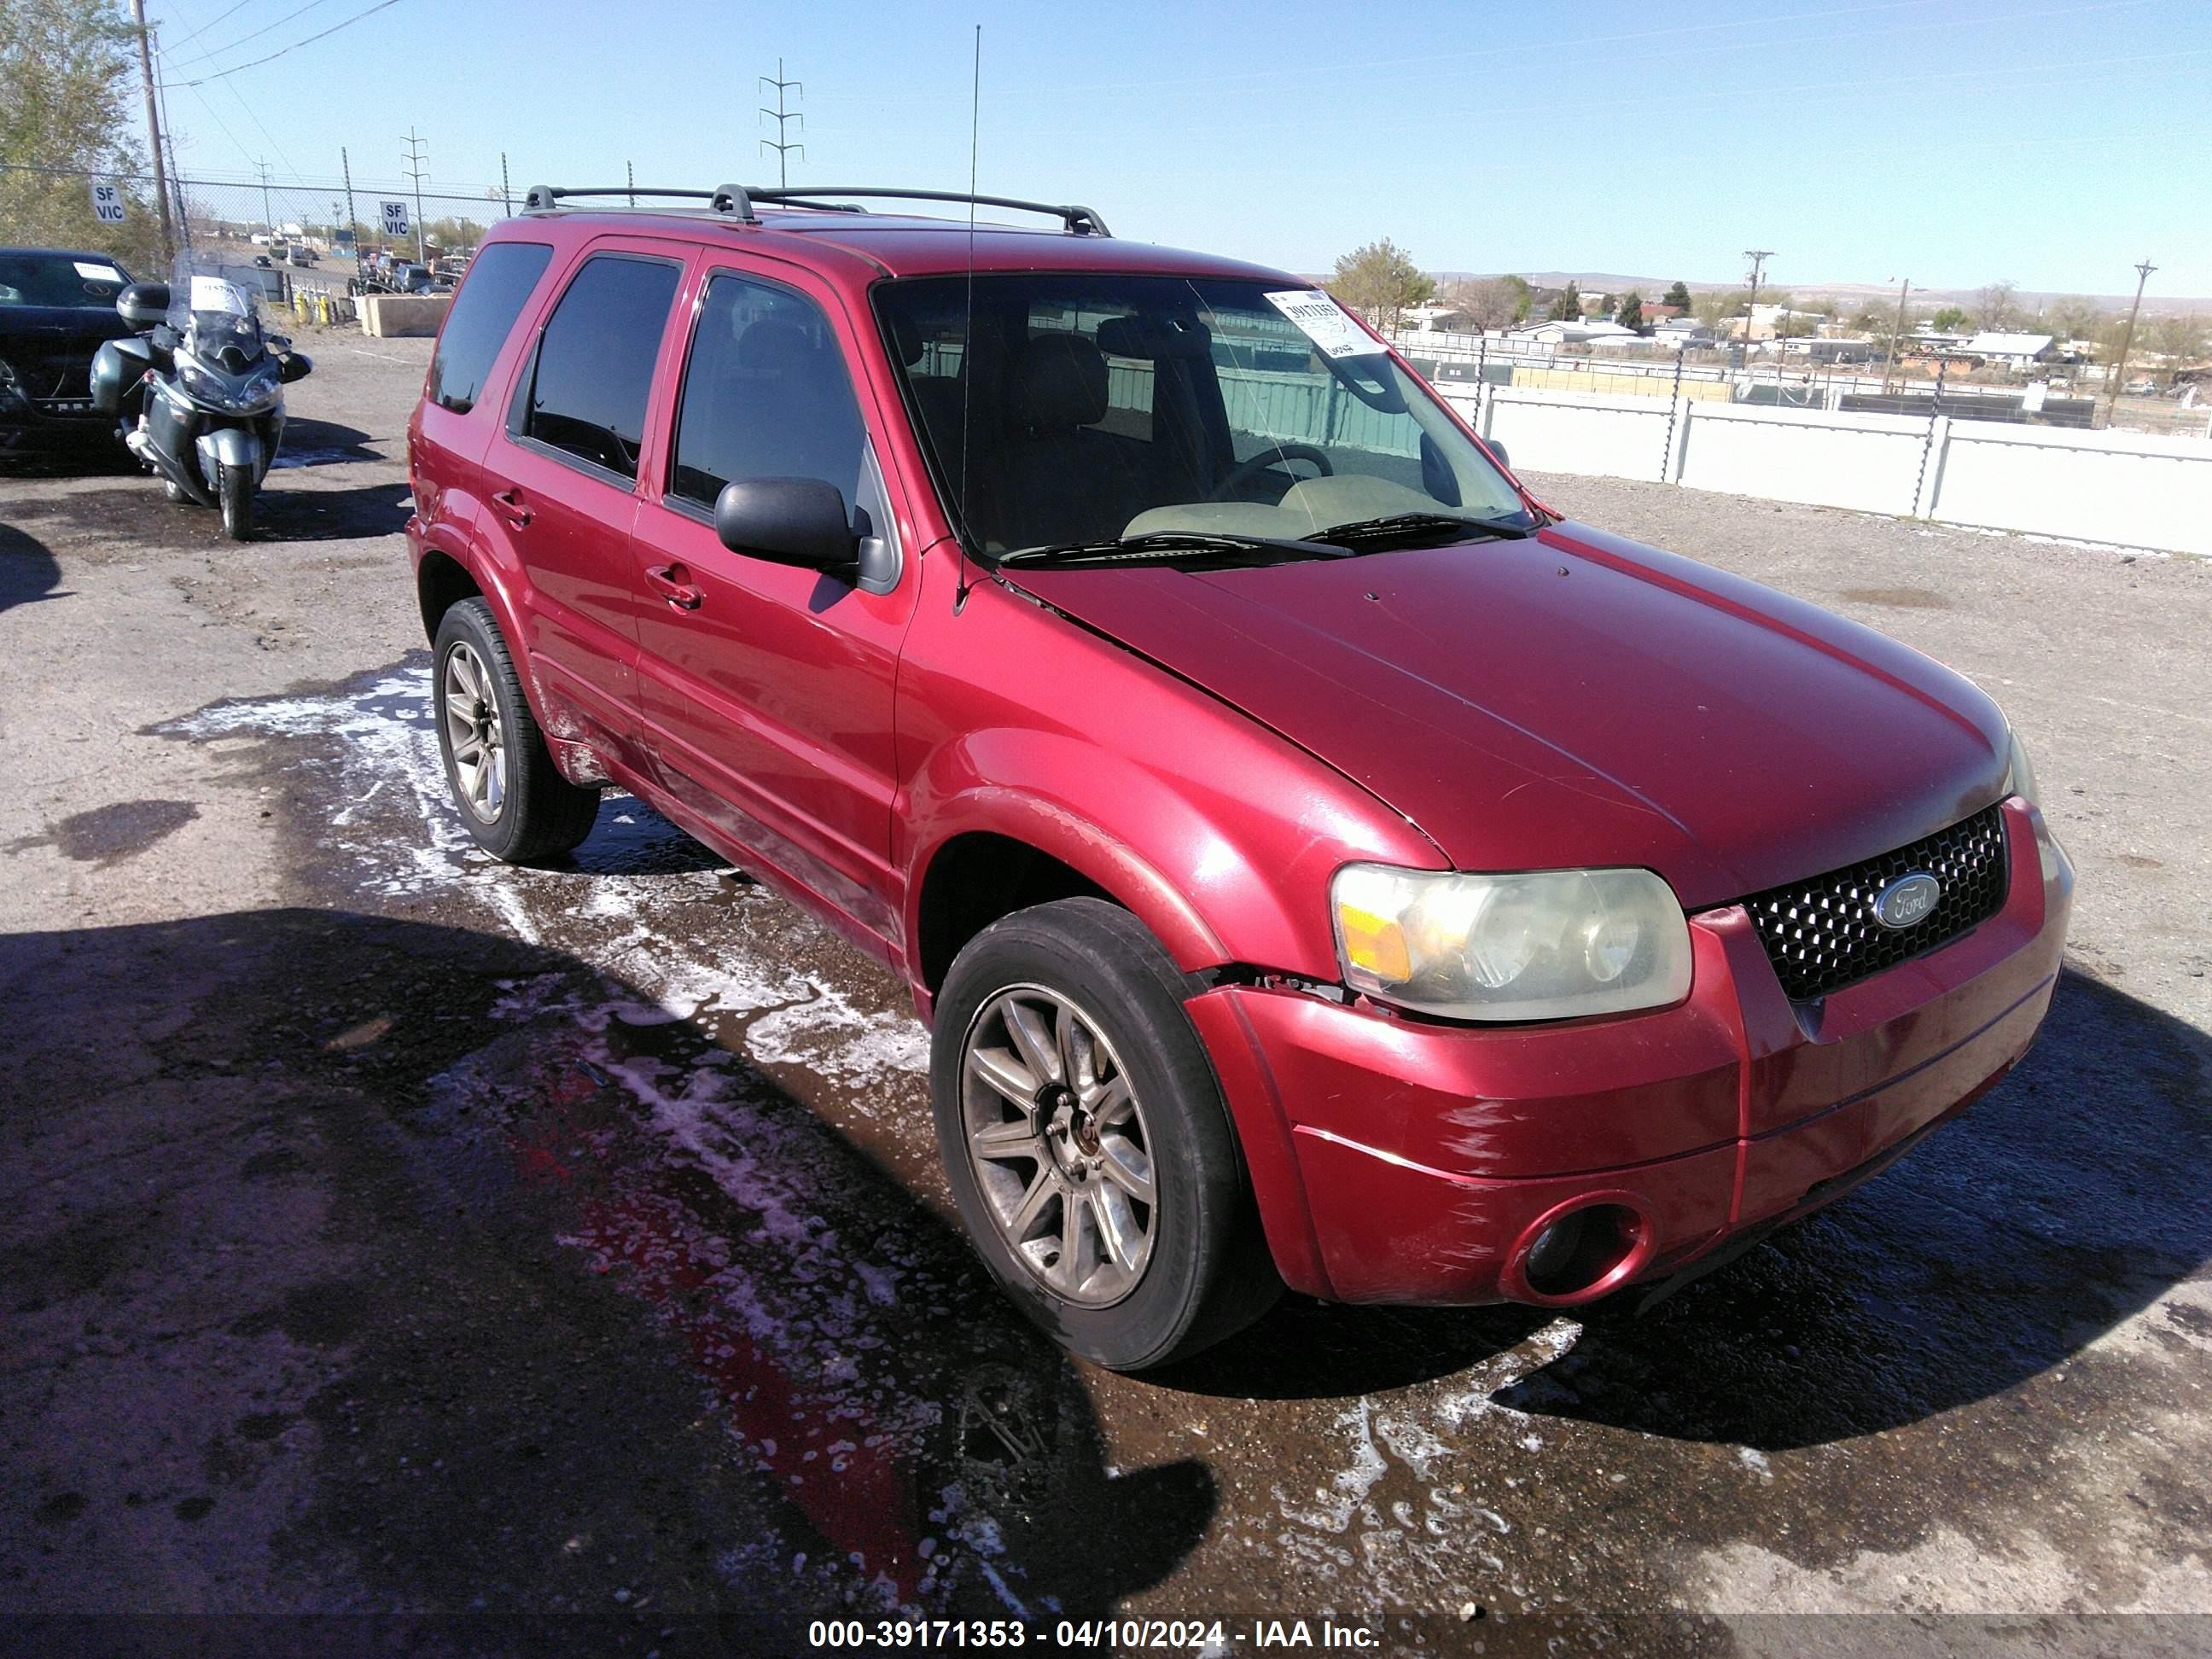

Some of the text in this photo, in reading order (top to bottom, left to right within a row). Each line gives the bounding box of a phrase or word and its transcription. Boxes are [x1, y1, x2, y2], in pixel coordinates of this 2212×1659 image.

[96, 187, 114, 201] SF
[96, 205, 123, 219] VIC
[386, 204, 401, 218] SF
[385, 221, 407, 235] VIC
[1286, 304, 1339, 318] 39171353
[1895, 885, 1927, 918] Ford
